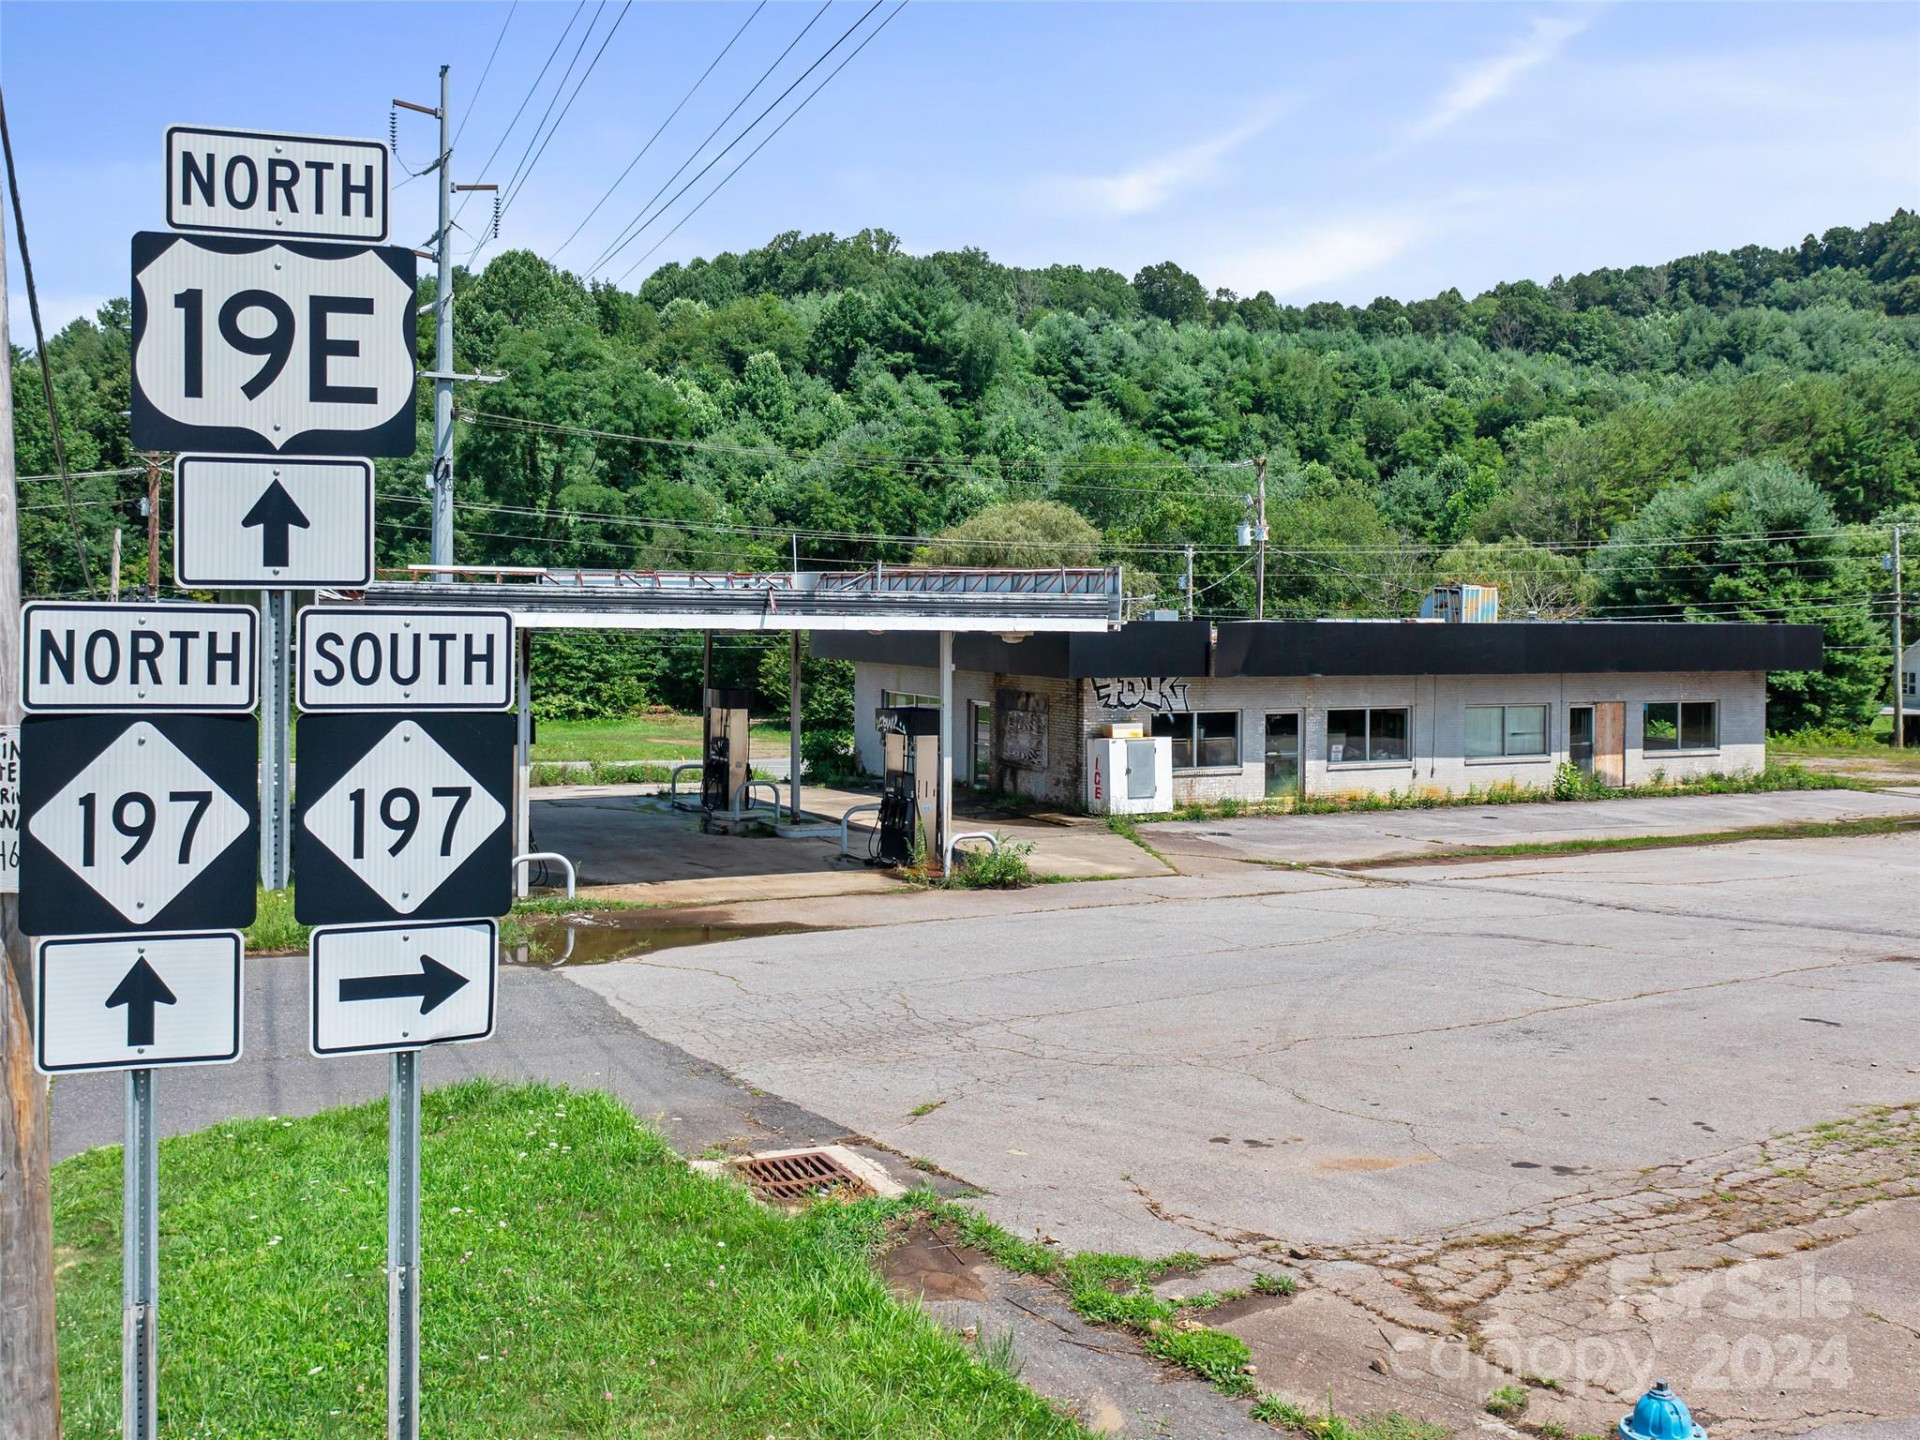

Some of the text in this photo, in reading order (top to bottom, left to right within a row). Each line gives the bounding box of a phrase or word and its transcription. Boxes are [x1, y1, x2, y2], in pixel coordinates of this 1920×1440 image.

[181, 151, 373, 218] NORTH
[174, 288, 378, 404] 19E
[40, 629, 240, 686] NORTH
[314, 632, 494, 687] SOUTH
[1094, 756, 1102, 800] ICE
[79, 791, 213, 867] 197
[349, 786, 473, 859] 197
